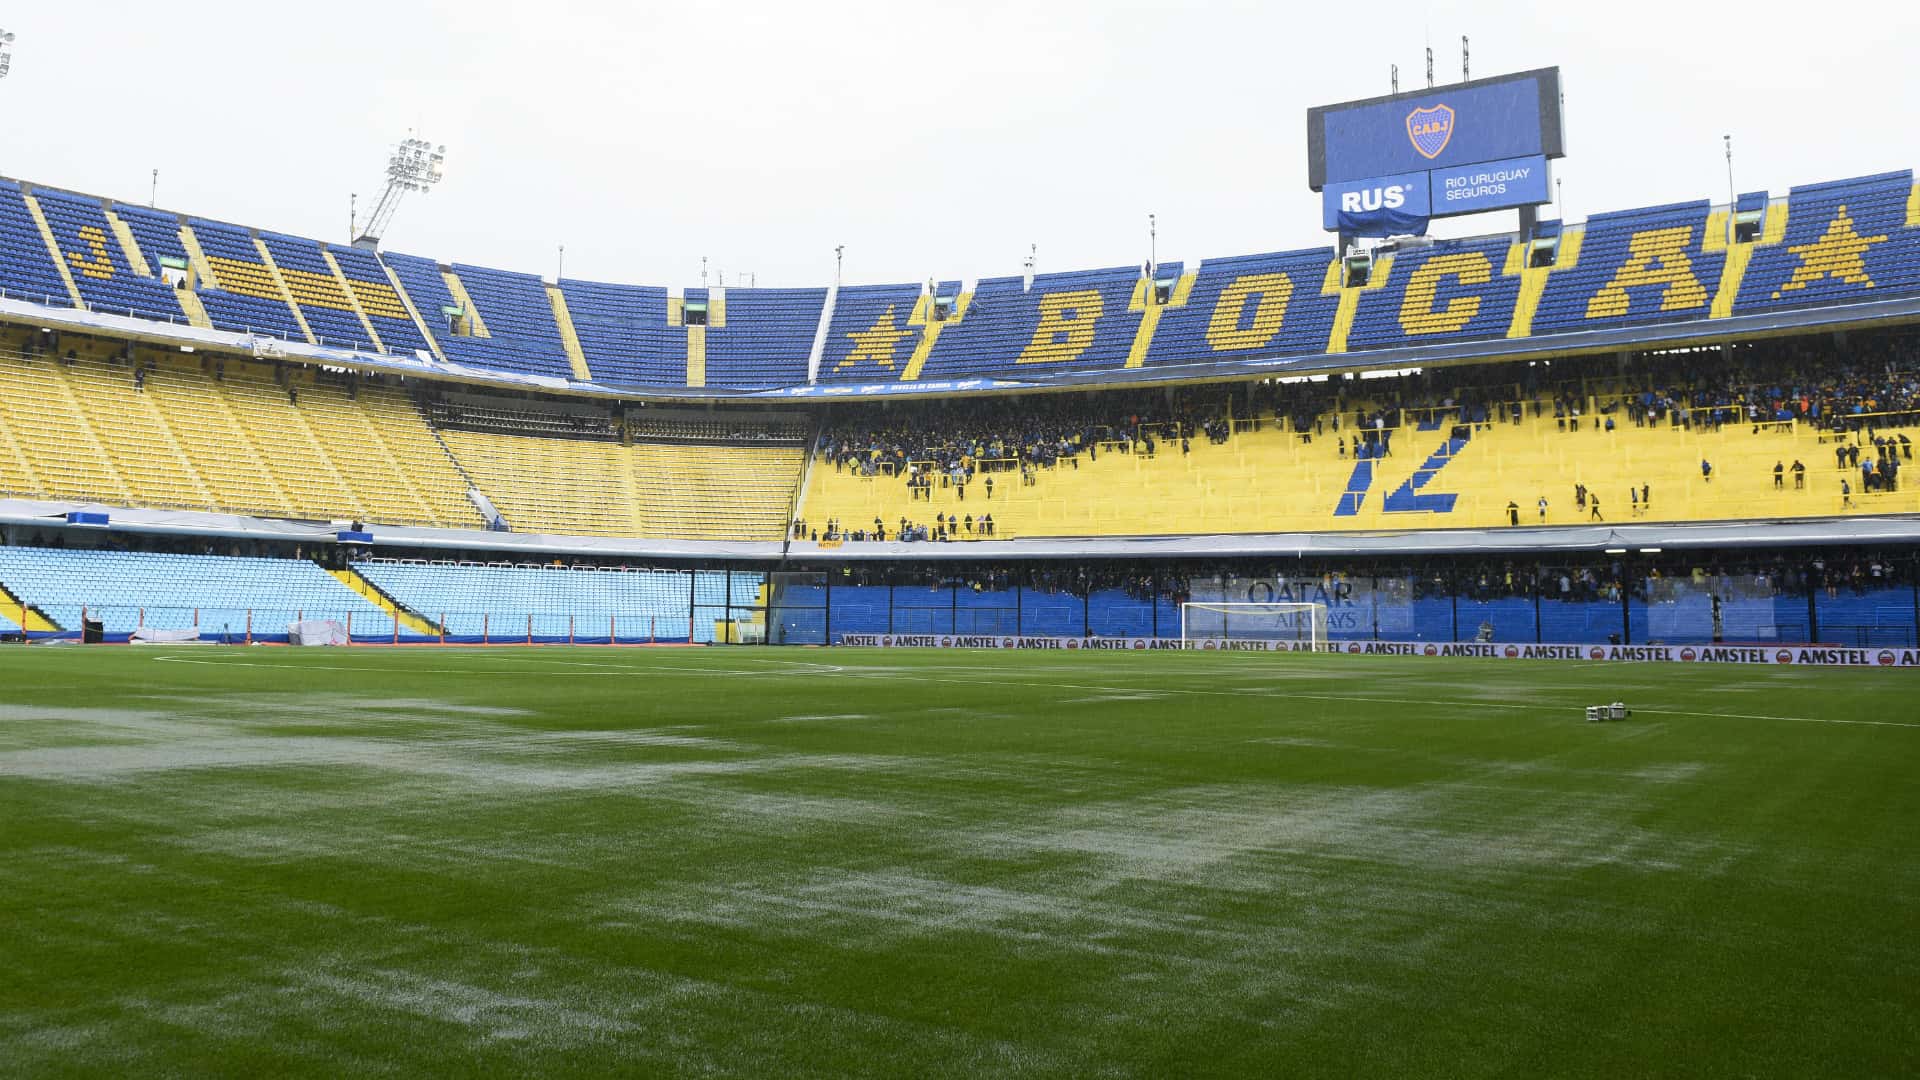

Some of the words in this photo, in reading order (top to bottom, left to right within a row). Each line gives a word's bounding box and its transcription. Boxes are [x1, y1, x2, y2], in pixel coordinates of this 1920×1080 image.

[1446, 177, 1467, 189] RIO
[1469, 168, 1530, 187] URUGUAY
[1446, 183, 1506, 200] SEGUROS
[1248, 582, 1354, 611] QATAR
[1275, 612, 1356, 629] AIRWAYS
[896, 636, 937, 647] AMSTEL
[955, 637, 998, 648] AMSTEL
[1017, 638, 1063, 649] AMSTEL
[1081, 640, 1128, 650] AMSTEL
[1220, 641, 1268, 651] AMSTEL
[1365, 643, 1418, 655] AMSTEL
[1442, 644, 1498, 657] AMSTEL
[1523, 646, 1582, 660] AMSTEL
[1610, 647, 1673, 660] AMSTEL
[1701, 649, 1768, 662] AMSTEL
[1798, 650, 1870, 664] AMSTEL
